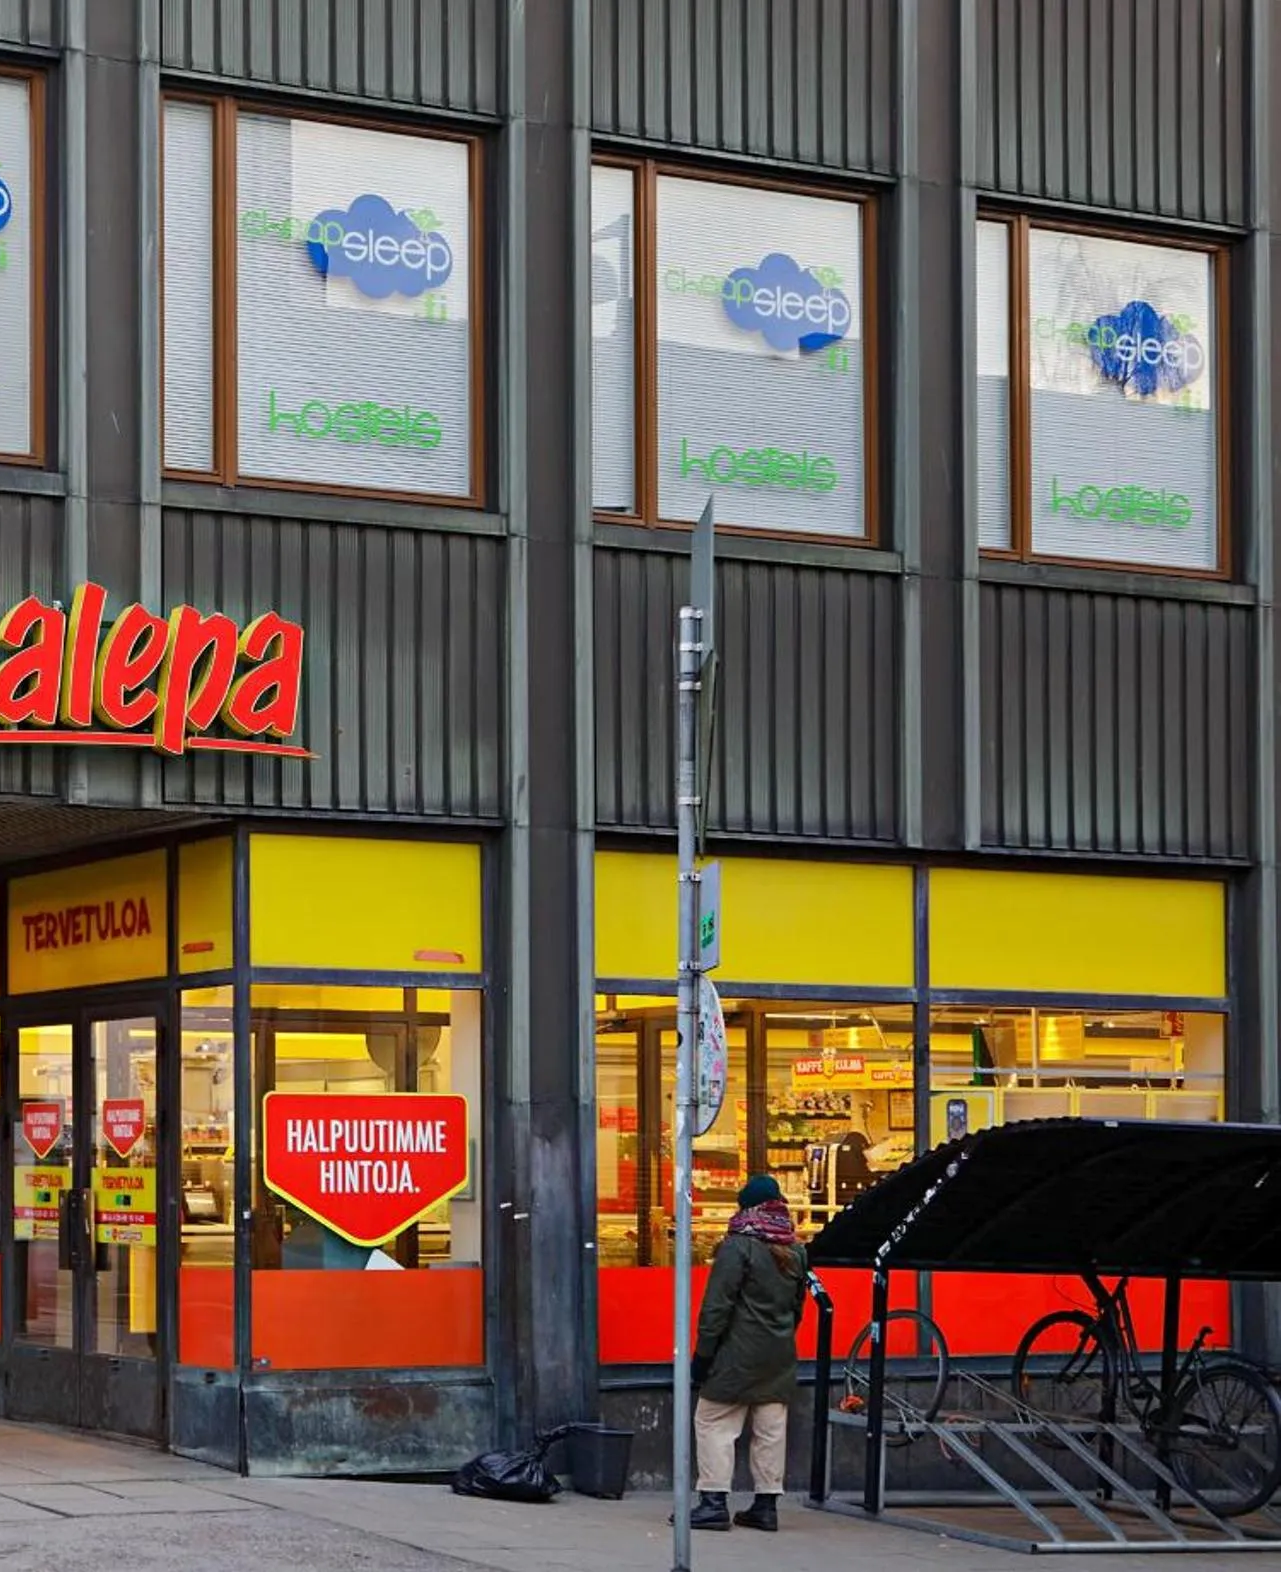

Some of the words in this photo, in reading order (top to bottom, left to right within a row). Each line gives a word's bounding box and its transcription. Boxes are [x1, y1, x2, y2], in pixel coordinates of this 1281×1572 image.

[268, 387, 443, 449] hostels
[22, 896, 152, 952] TERVETULOA
[286, 1119, 447, 1153] HALPUUTIMME
[320, 1159, 421, 1194] HINTOJA.
